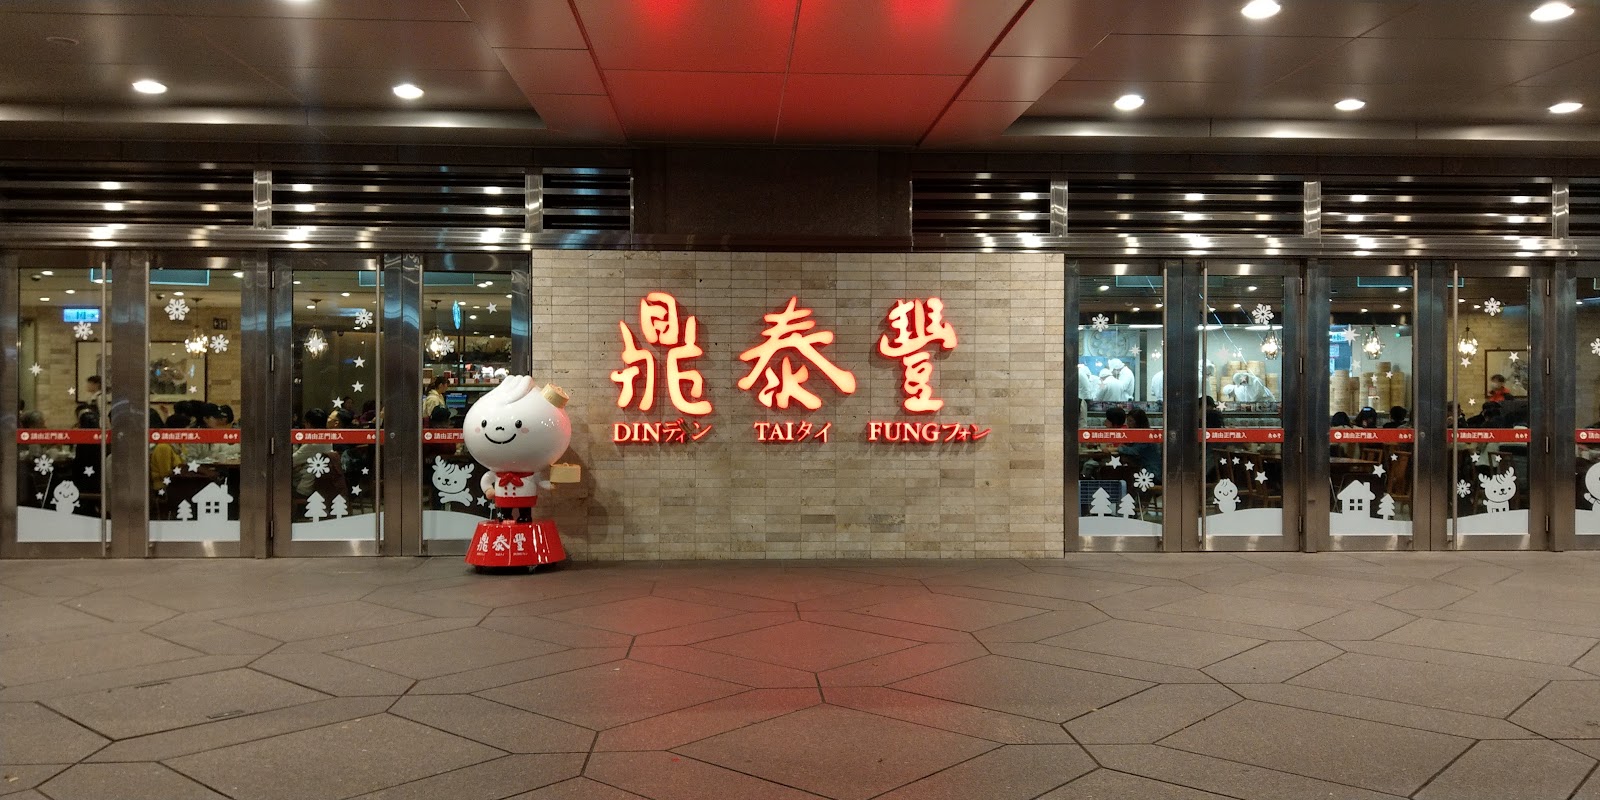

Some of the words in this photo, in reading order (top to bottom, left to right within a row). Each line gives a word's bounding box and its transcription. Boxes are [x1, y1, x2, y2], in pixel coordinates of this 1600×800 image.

[610, 292, 959, 415] 鼎泰豐
[753, 421, 831, 442] TAIタイ
[477, 532, 527, 552] 鼎泰豐
